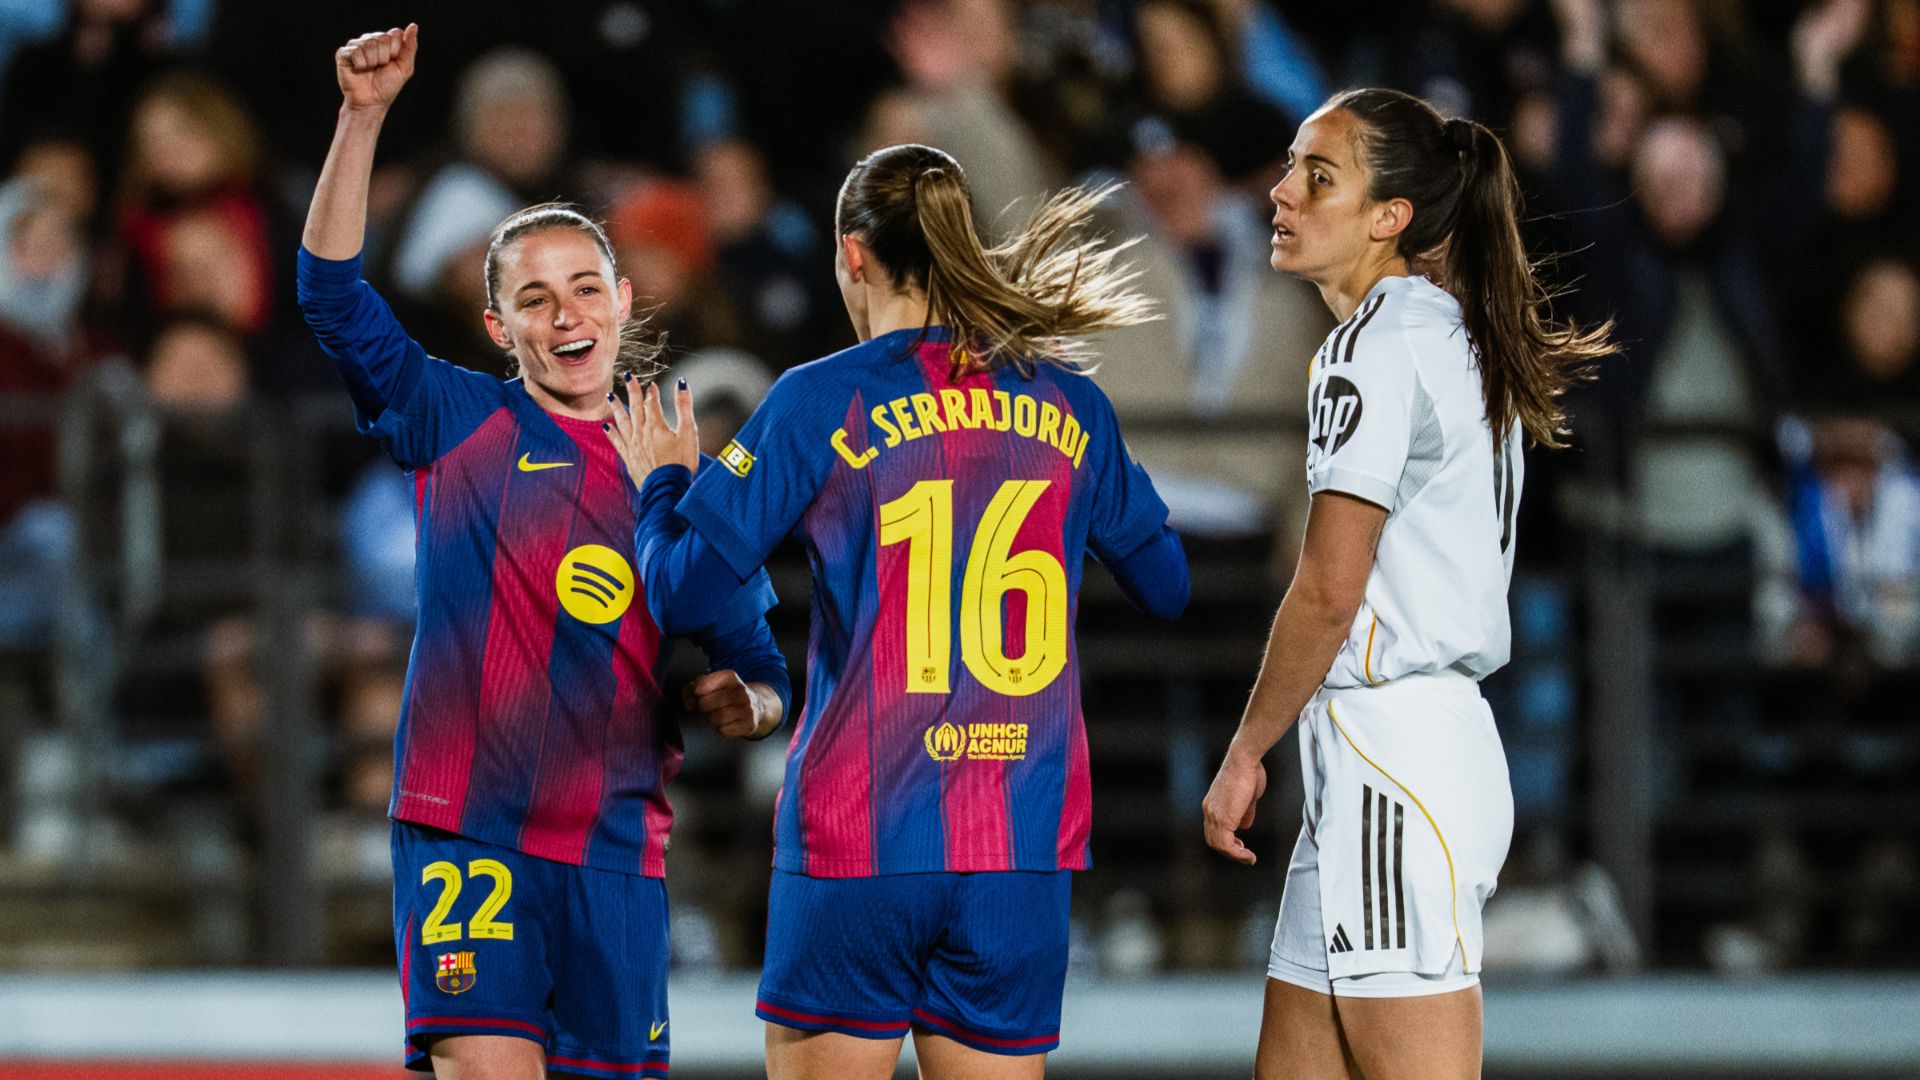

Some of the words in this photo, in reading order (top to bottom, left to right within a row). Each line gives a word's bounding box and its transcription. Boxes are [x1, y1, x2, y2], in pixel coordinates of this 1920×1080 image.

[831, 428, 879, 469] C.
[871, 388, 1090, 469] SERRAJORDI
[1313, 376, 1358, 456] hp
[880, 479, 1068, 697] 16
[966, 738, 1027, 753] ACNUR
[968, 723, 1029, 739] UNHCR
[422, 858, 514, 946] 22
